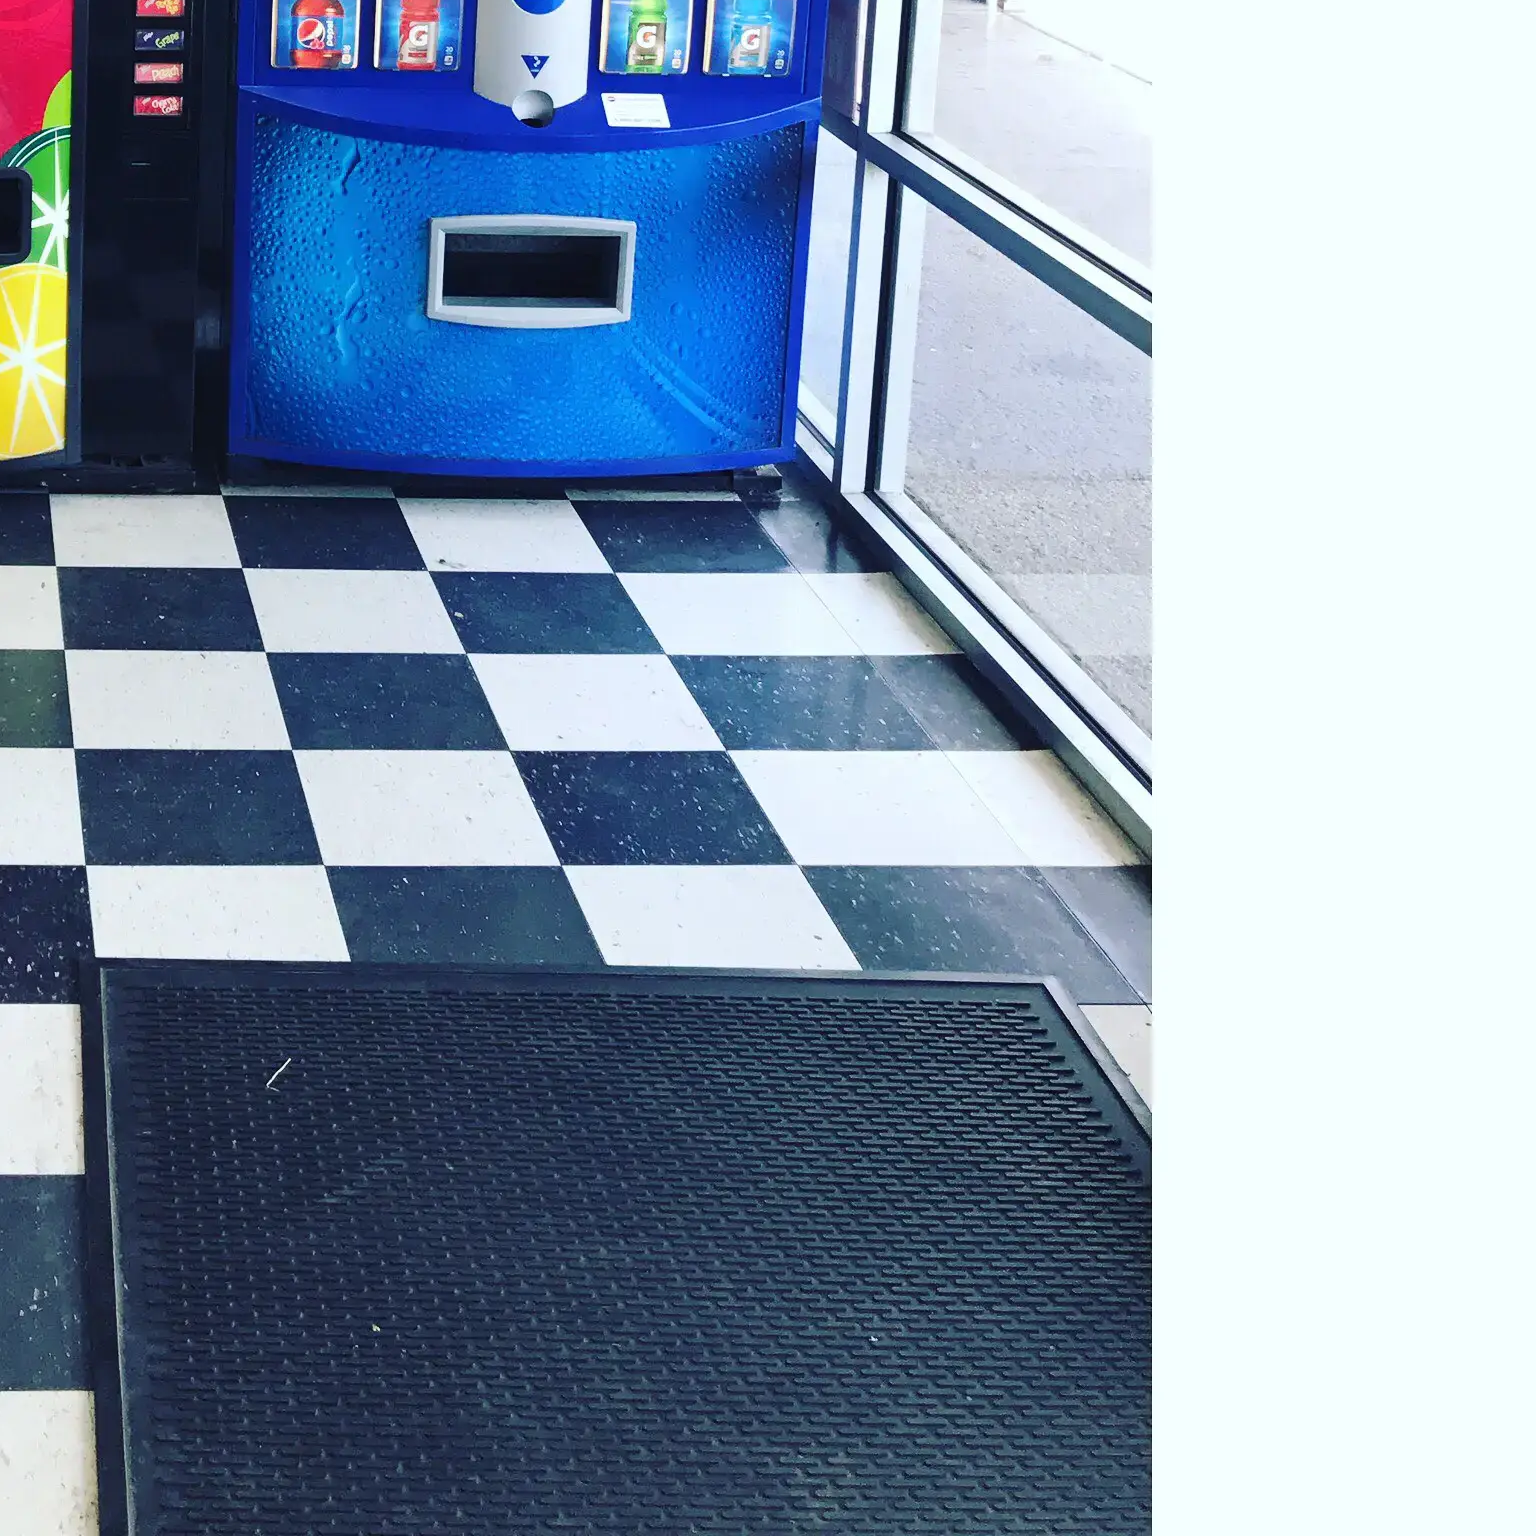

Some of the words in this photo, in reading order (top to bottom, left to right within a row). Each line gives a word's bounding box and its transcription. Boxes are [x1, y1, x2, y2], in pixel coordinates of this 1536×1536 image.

[410, 23, 428, 46] G
[636, 26, 657, 48] G
[740, 28, 761, 50] G
